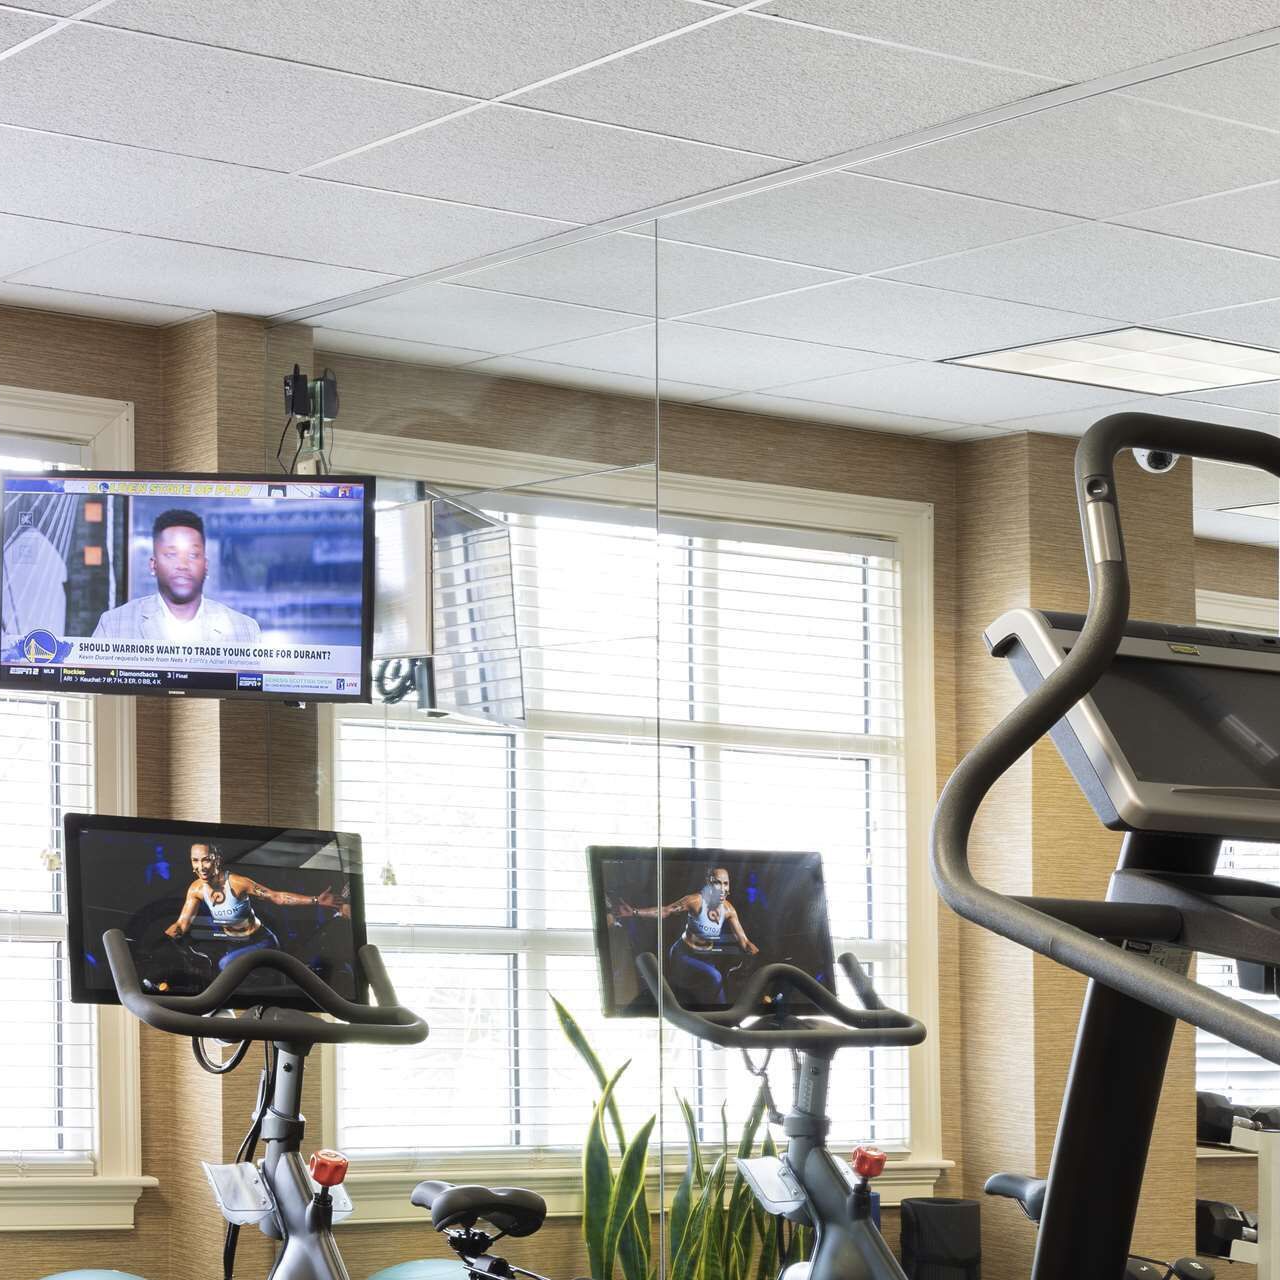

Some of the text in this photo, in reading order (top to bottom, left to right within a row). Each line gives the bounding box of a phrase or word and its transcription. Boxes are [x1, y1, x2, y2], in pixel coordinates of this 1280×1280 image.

[149, 483, 191, 496] STATE
[214, 484, 253, 497] PLAY
[79, 642, 331, 661] SHOULD WARRIORS WANT TO TRADE YOUNG CORE FOR DURANT?
[63, 667, 86, 676] Rockies
[119, 669, 158, 679] Diamondbacks
